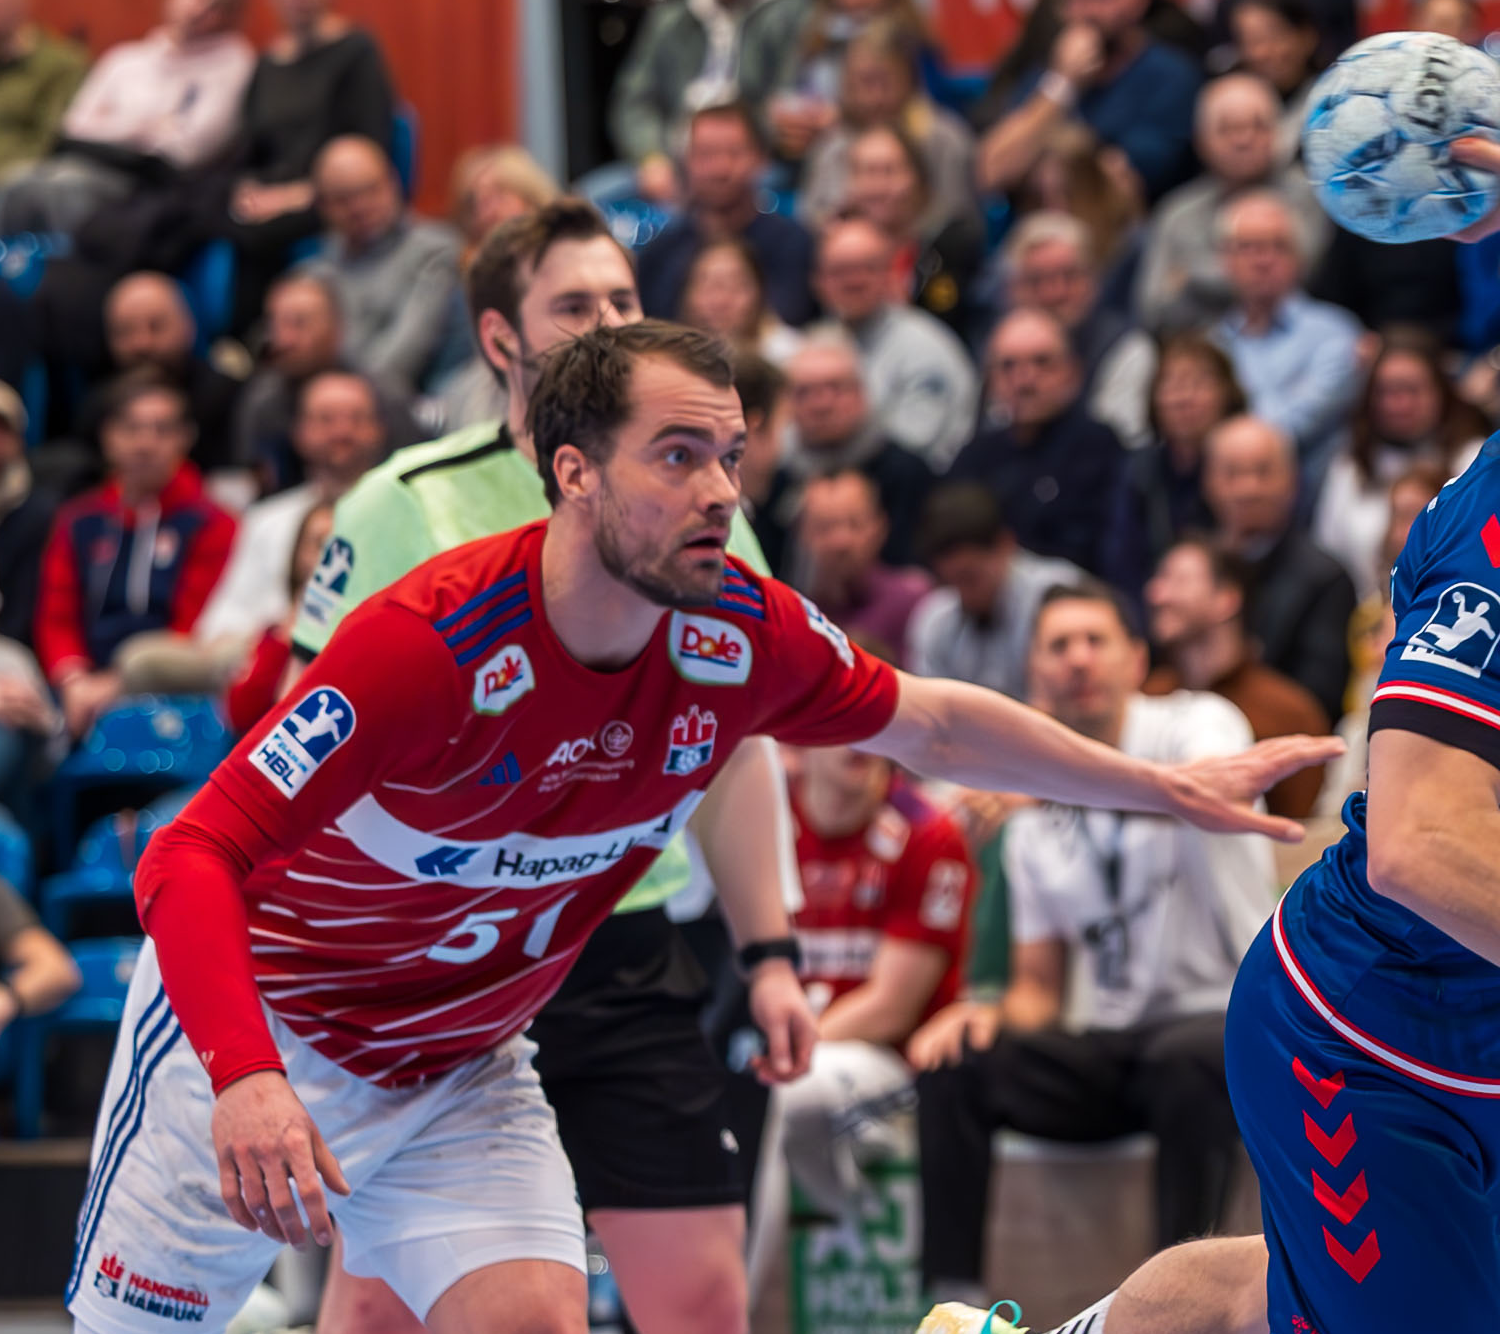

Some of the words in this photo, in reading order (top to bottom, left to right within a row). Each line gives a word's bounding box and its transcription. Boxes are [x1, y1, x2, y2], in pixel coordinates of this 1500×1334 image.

[680, 624, 743, 663] Dole
[257, 743, 295, 789] HBL
[426, 890, 579, 964] 51
[128, 1272, 210, 1307] HANDBALL
